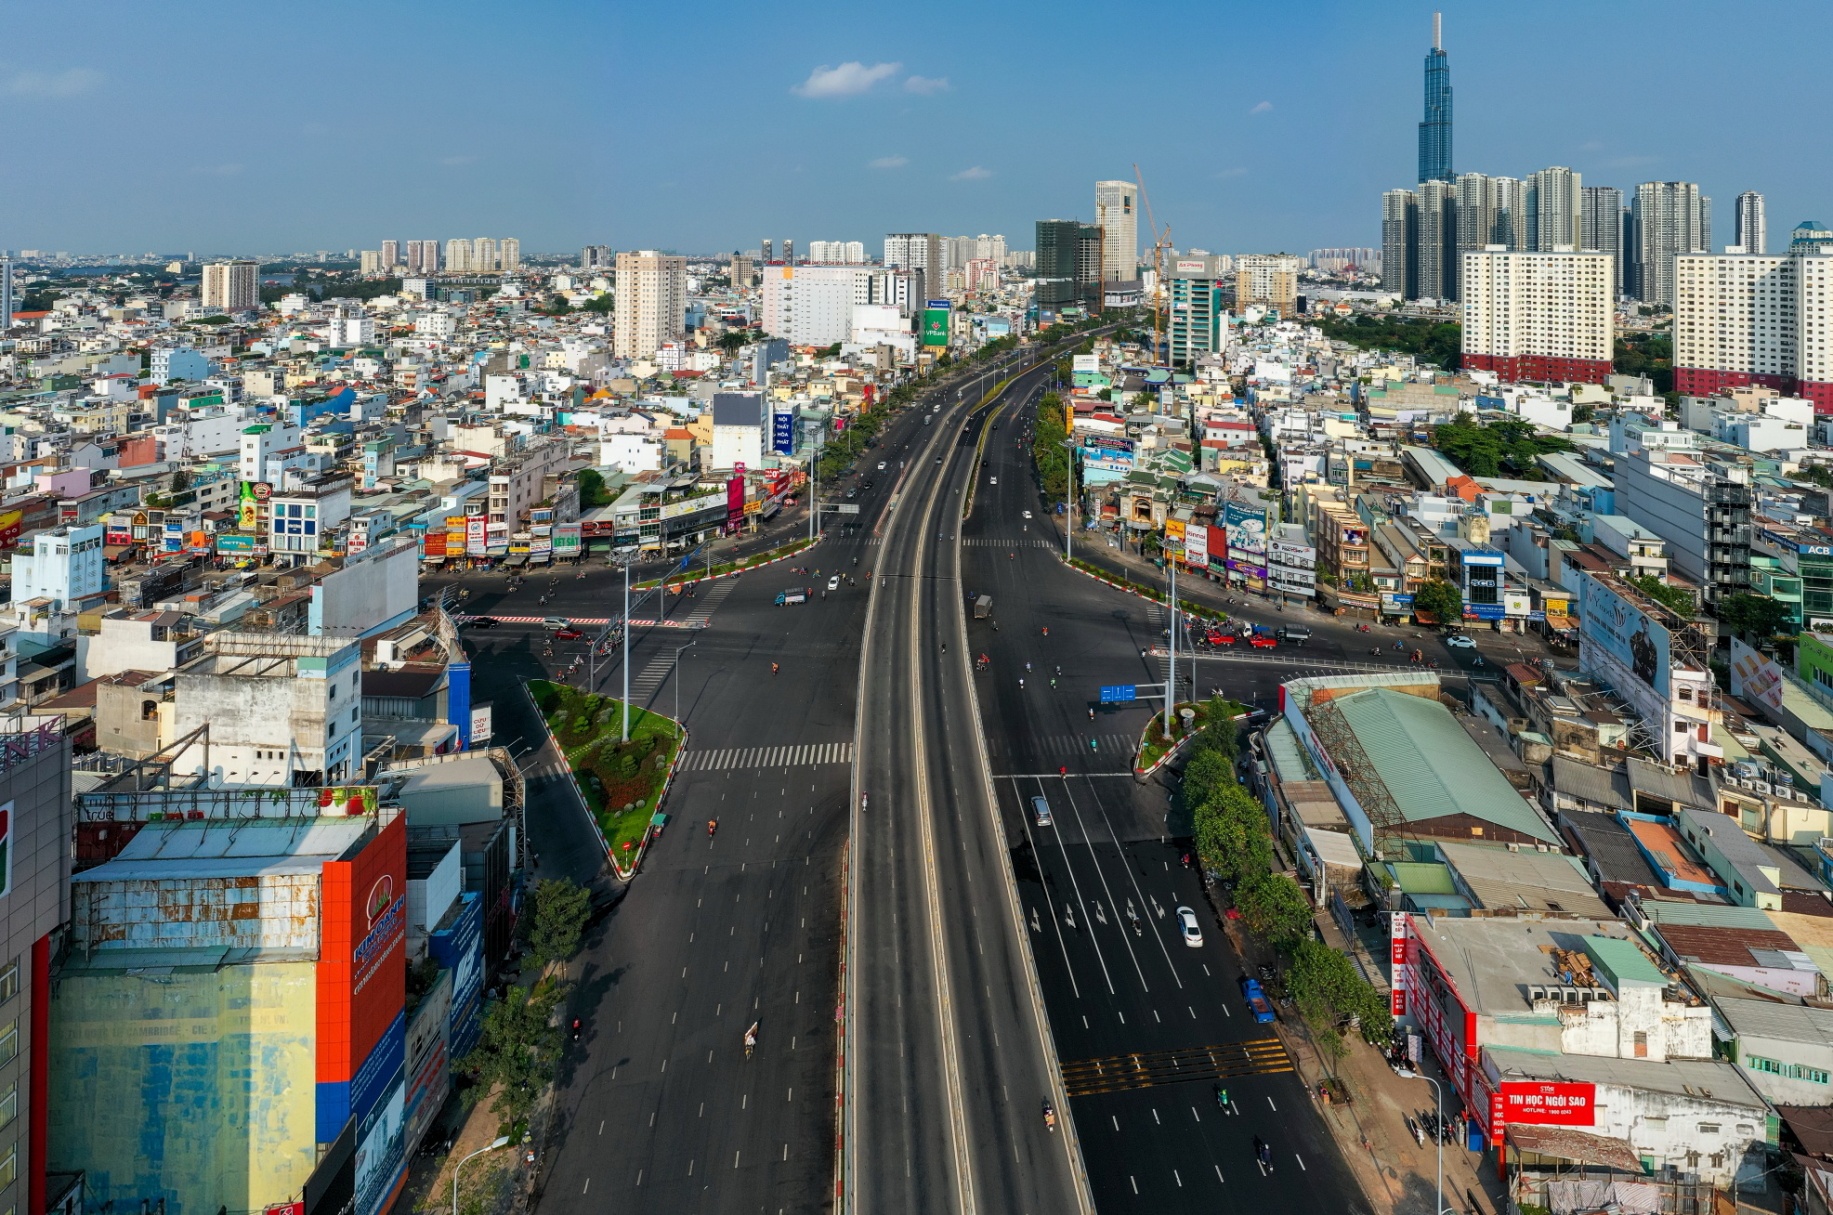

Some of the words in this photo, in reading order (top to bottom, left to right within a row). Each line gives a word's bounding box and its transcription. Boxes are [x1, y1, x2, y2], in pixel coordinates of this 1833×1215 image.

[1187, 530, 1206, 539] Rinnai
[1808, 546, 1830, 555] ACB
[1470, 578, 1495, 588] SCB
[86, 809, 113, 821] true
[354, 929, 375, 963] KIM
[375, 894, 405, 934] OANH
[1509, 1095, 1523, 1104] TIN
[1525, 1095, 1543, 1107] HỌC
[1545, 1094, 1567, 1106] NGÔI
[1568, 1096, 1586, 1106] SAO
